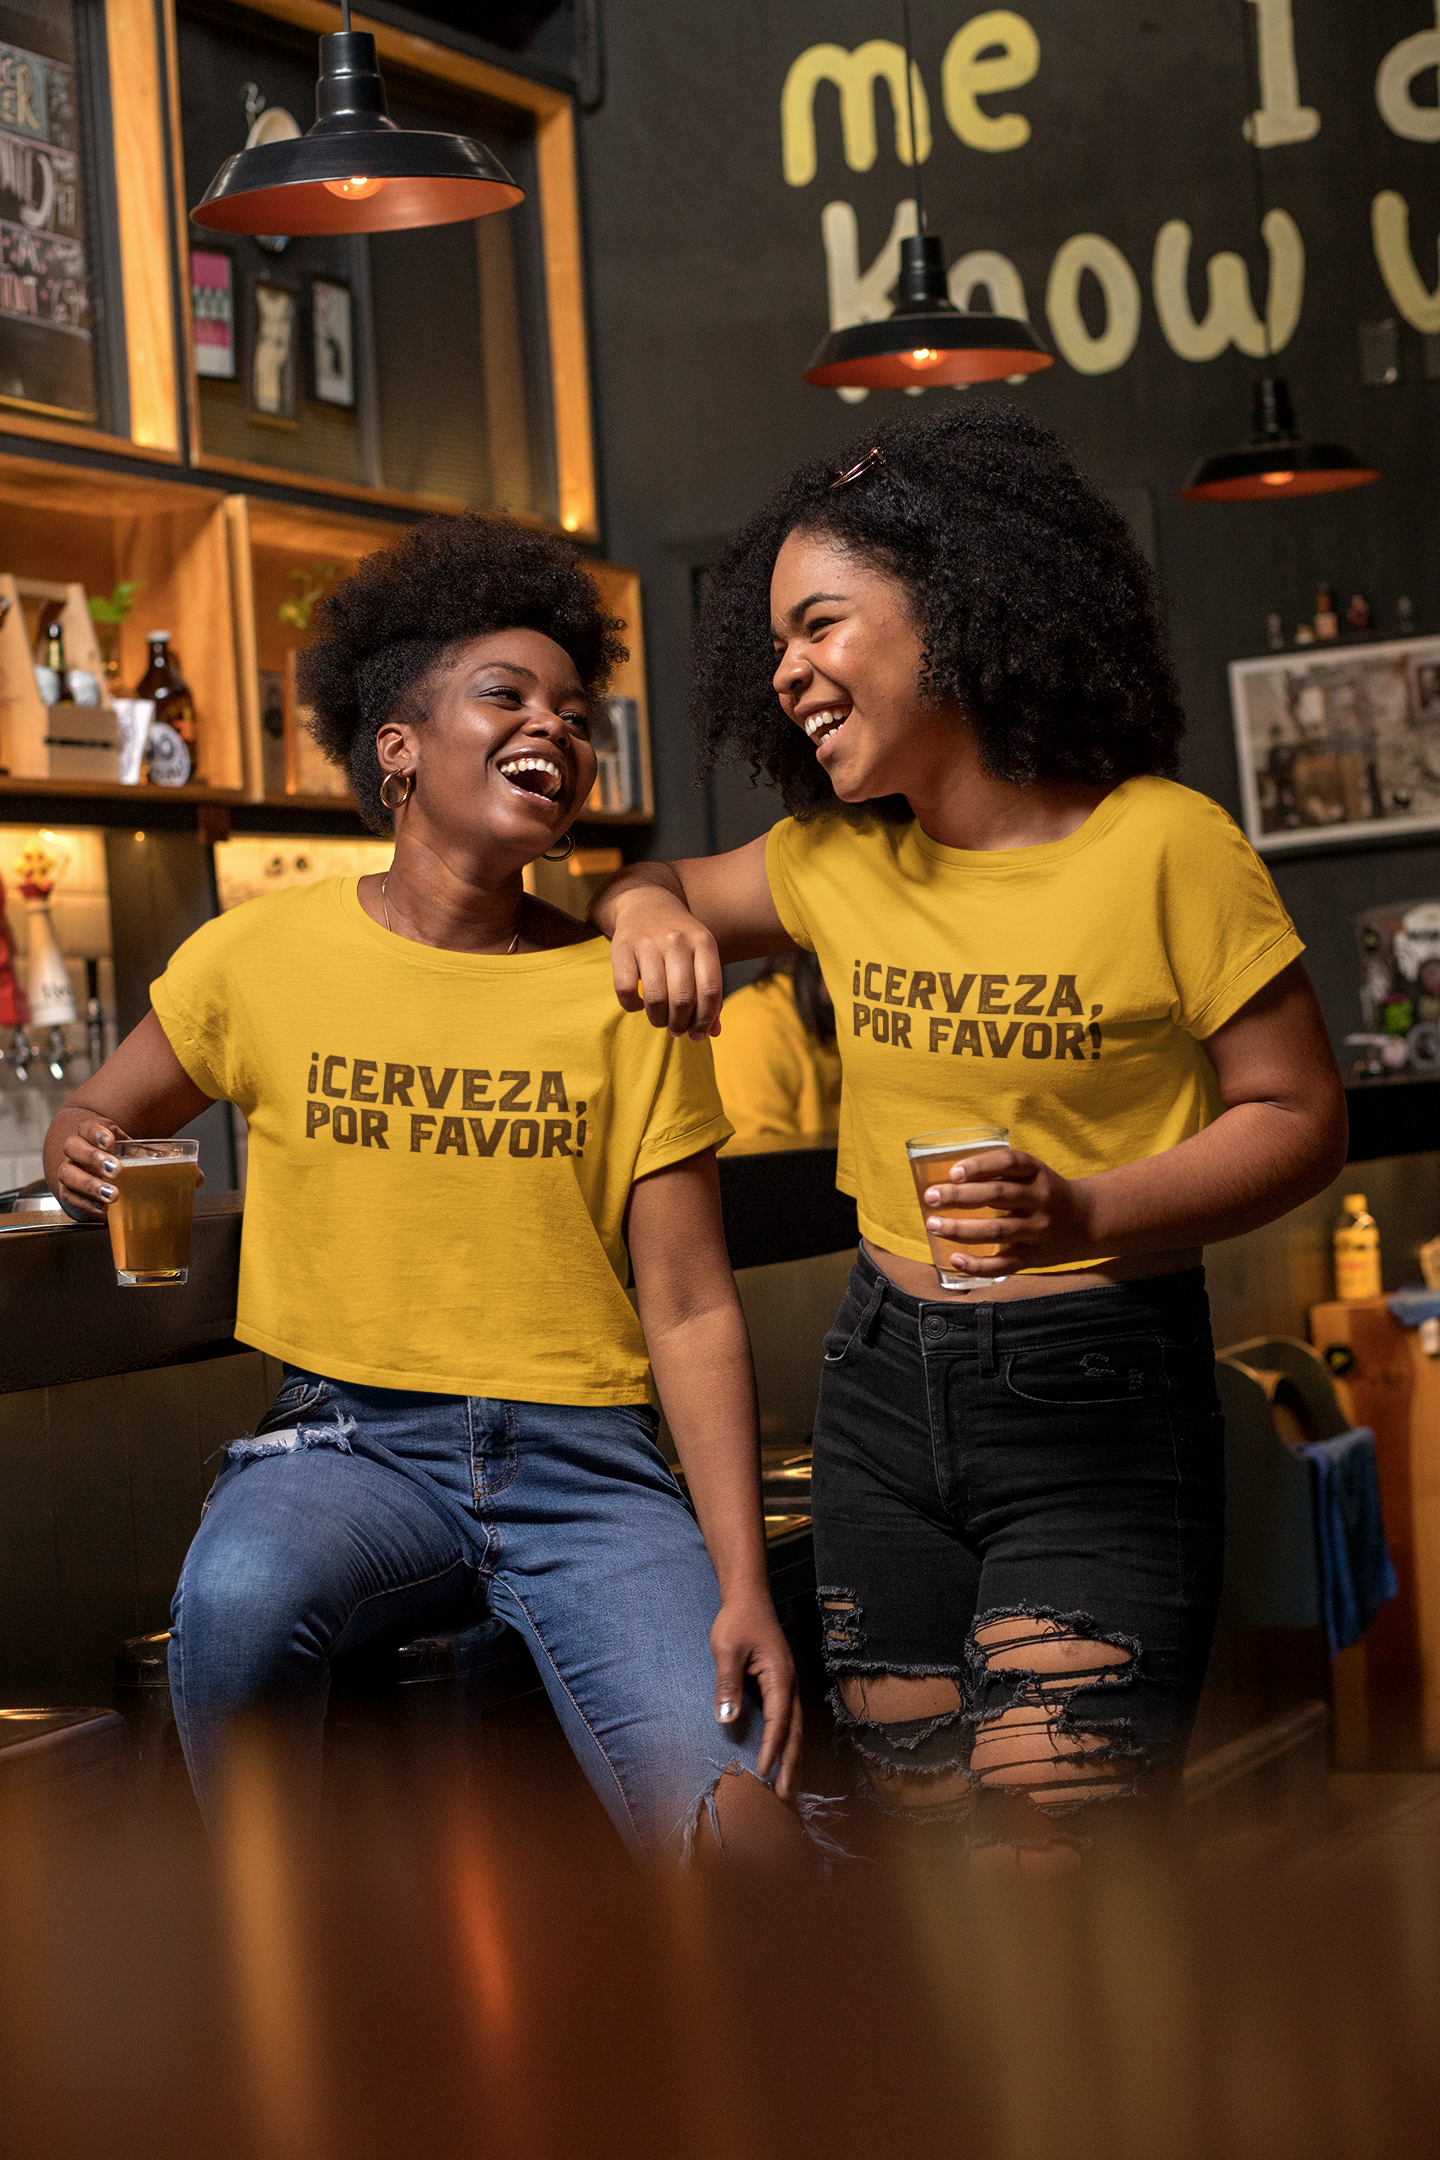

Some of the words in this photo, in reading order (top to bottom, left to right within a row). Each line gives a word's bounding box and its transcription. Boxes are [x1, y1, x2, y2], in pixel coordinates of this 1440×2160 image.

[781, 10, 1040, 187] me
[853, 1001, 913, 1049] POR
[928, 1016, 1103, 1060] FAVOR!
[305, 1100, 391, 1149] POR
[409, 1113, 587, 1158] FAVOR!
